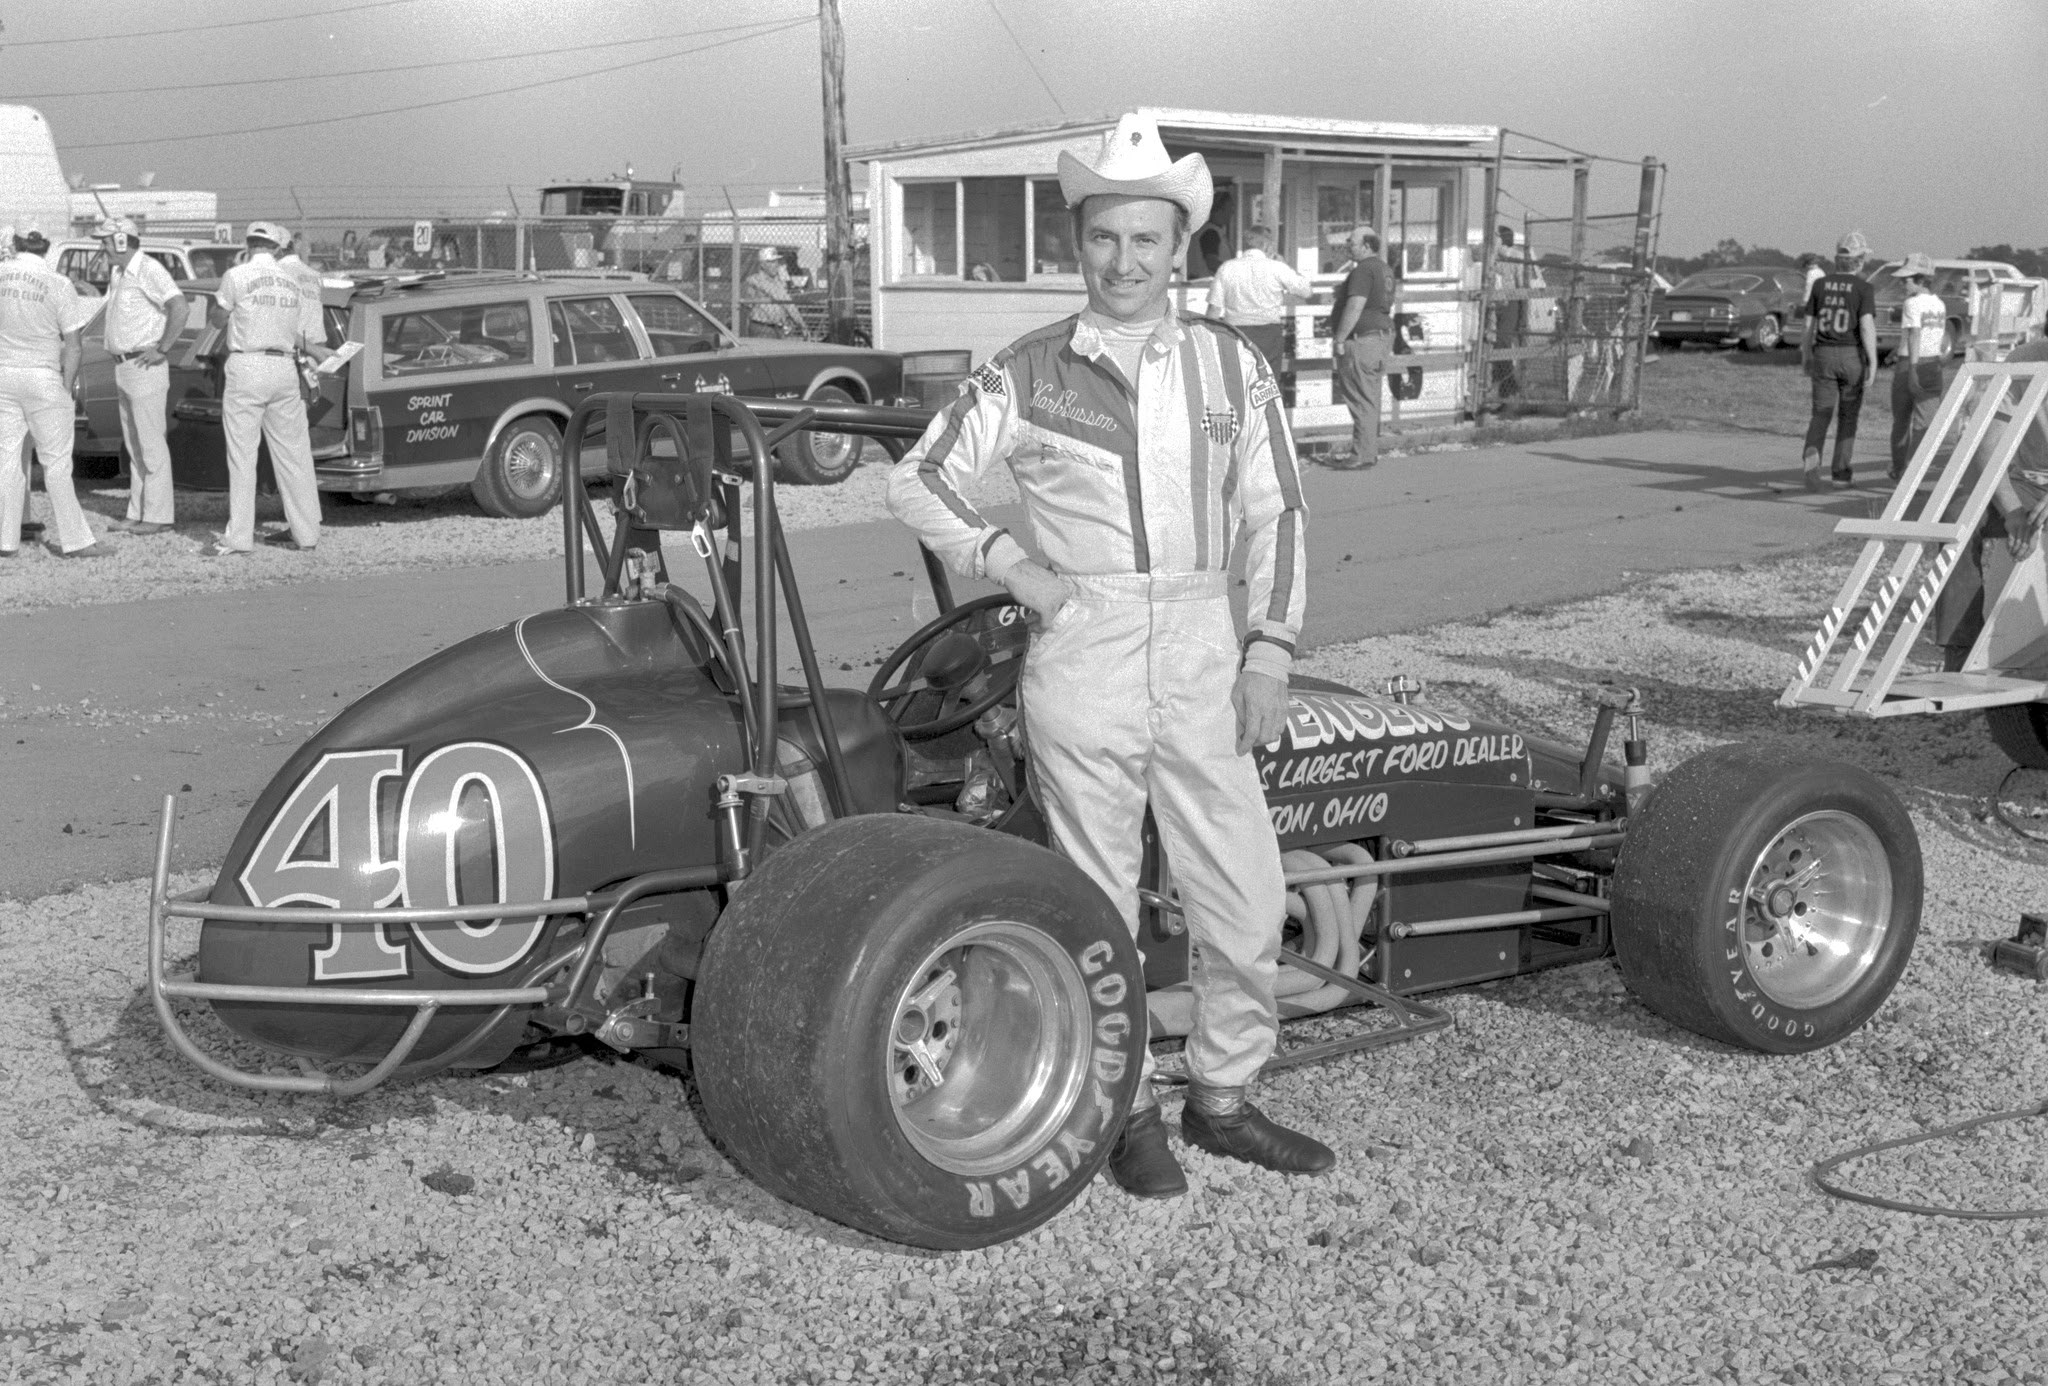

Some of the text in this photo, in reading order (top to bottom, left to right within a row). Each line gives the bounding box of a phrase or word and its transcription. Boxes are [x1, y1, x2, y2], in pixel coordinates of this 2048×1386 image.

[416, 226, 429, 246] 20
[252, 294, 276, 306] AUTO
[1818, 307, 1850, 333] 20
[407, 393, 453, 411] SPRINT
[420, 411, 447, 426] CAR
[406, 424, 460, 443] DIVISION
[1279, 748, 1384, 789] LARGEST
[1383, 739, 1449, 776] FORD
[1452, 734, 1527, 767] DEALER
[1322, 792, 1389, 829] OHIO
[239, 741, 555, 981] 40
